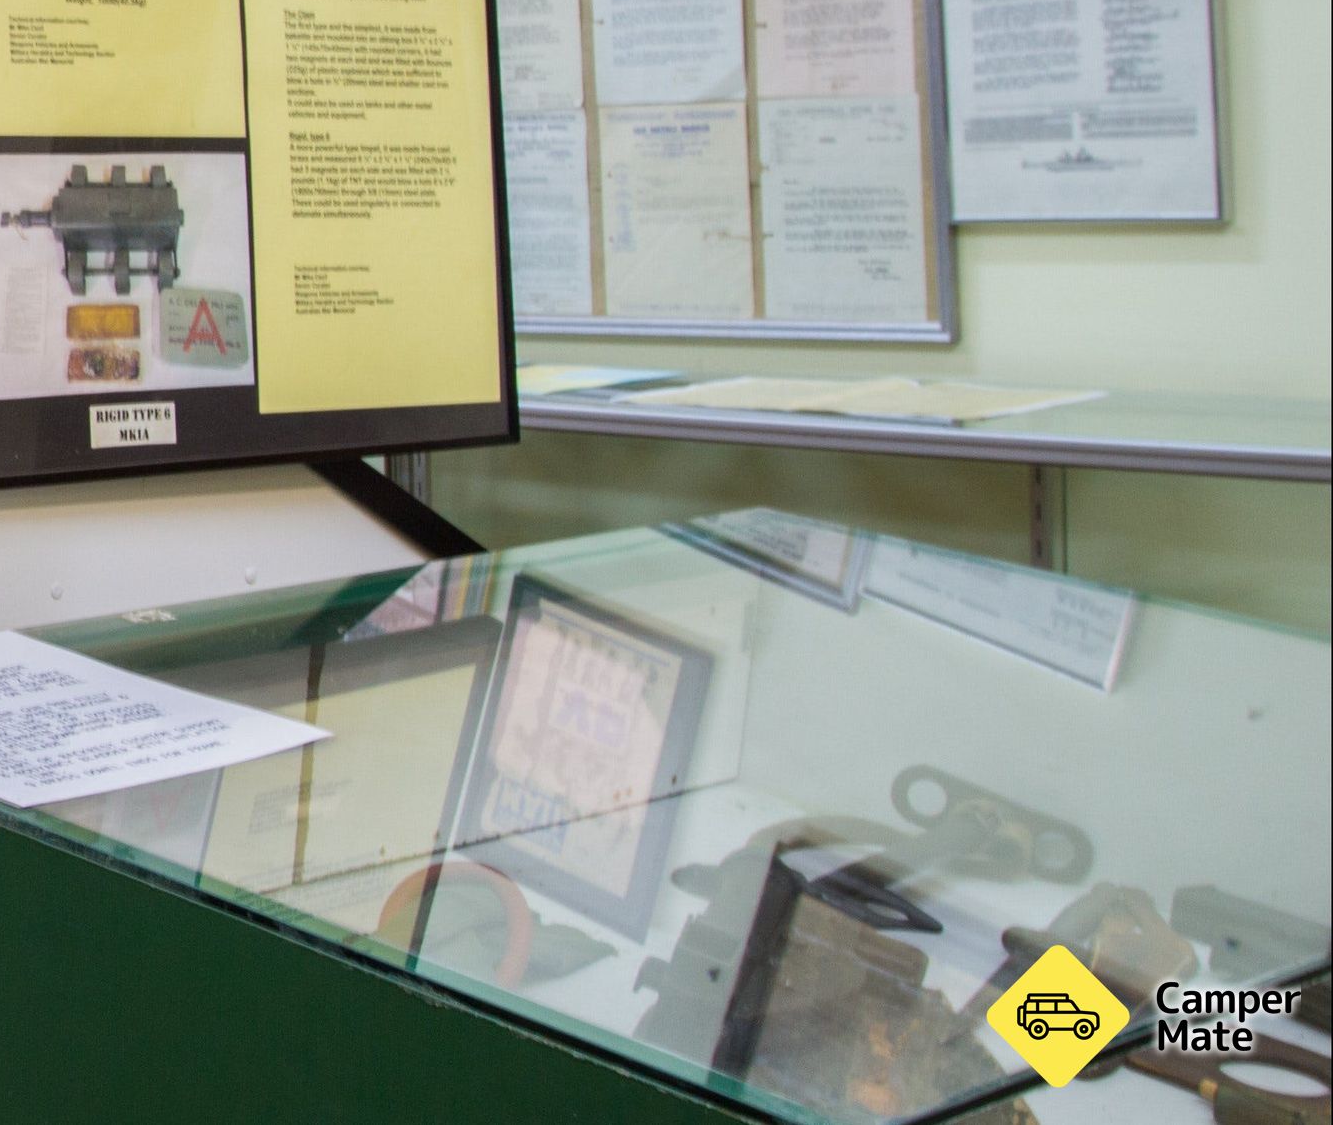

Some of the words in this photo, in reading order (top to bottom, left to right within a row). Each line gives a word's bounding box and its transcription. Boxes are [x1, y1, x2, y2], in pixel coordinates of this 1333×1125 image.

[183, 296, 227, 356] A
[96, 409, 129, 423] RIGID
[131, 408, 161, 422] TYPE
[164, 407, 171, 421] 6
